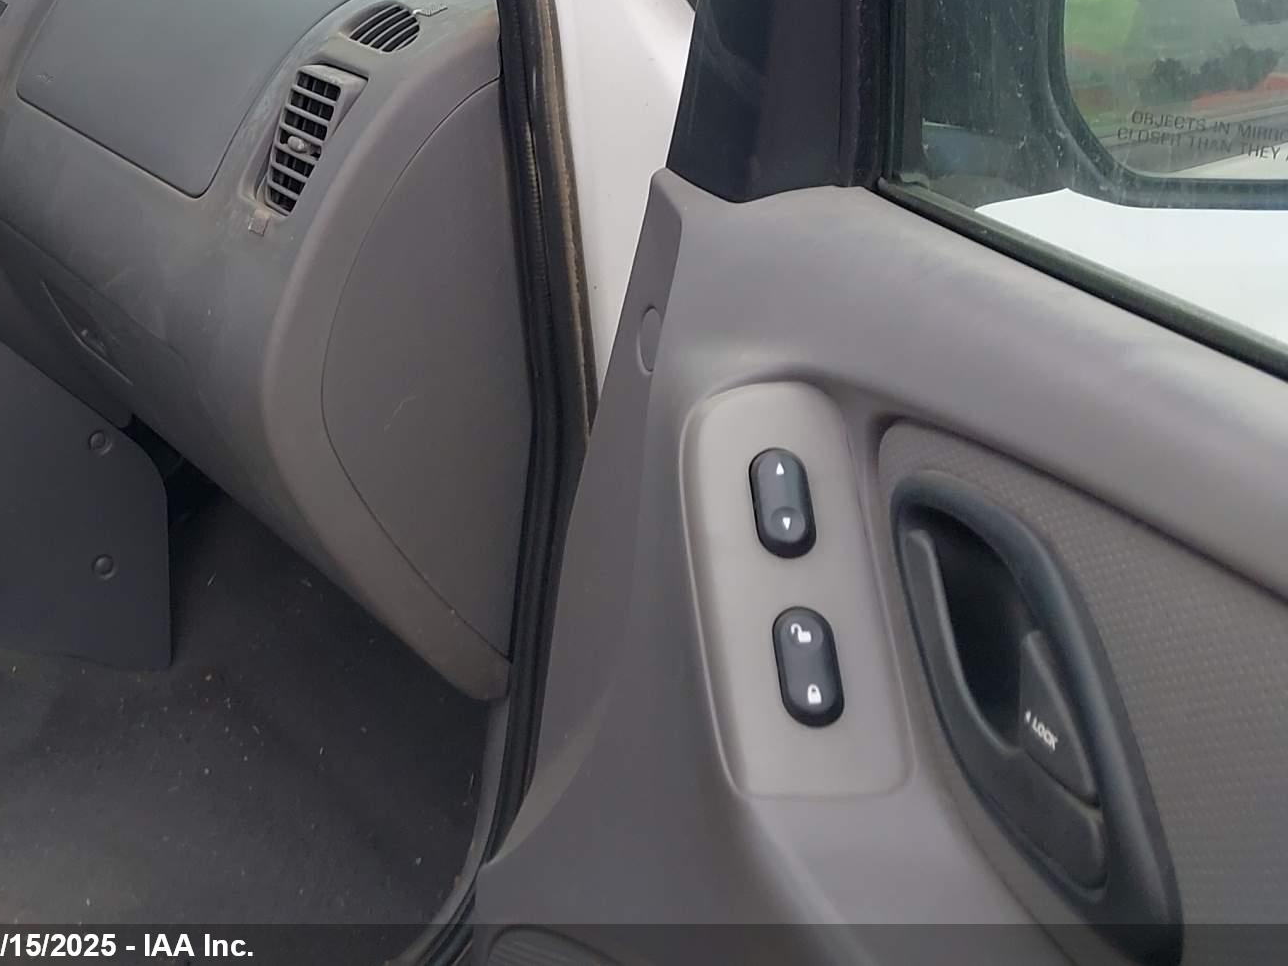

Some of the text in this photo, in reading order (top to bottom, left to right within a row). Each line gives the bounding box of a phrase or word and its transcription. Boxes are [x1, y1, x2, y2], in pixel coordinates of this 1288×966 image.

[1132, 110, 1208, 131] OBJECTS
[1214, 121, 1231, 135] IN
[1190, 136, 1232, 154] THAN
[1241, 142, 1281, 160] THEY
[1031, 716, 1059, 752] LOCK
